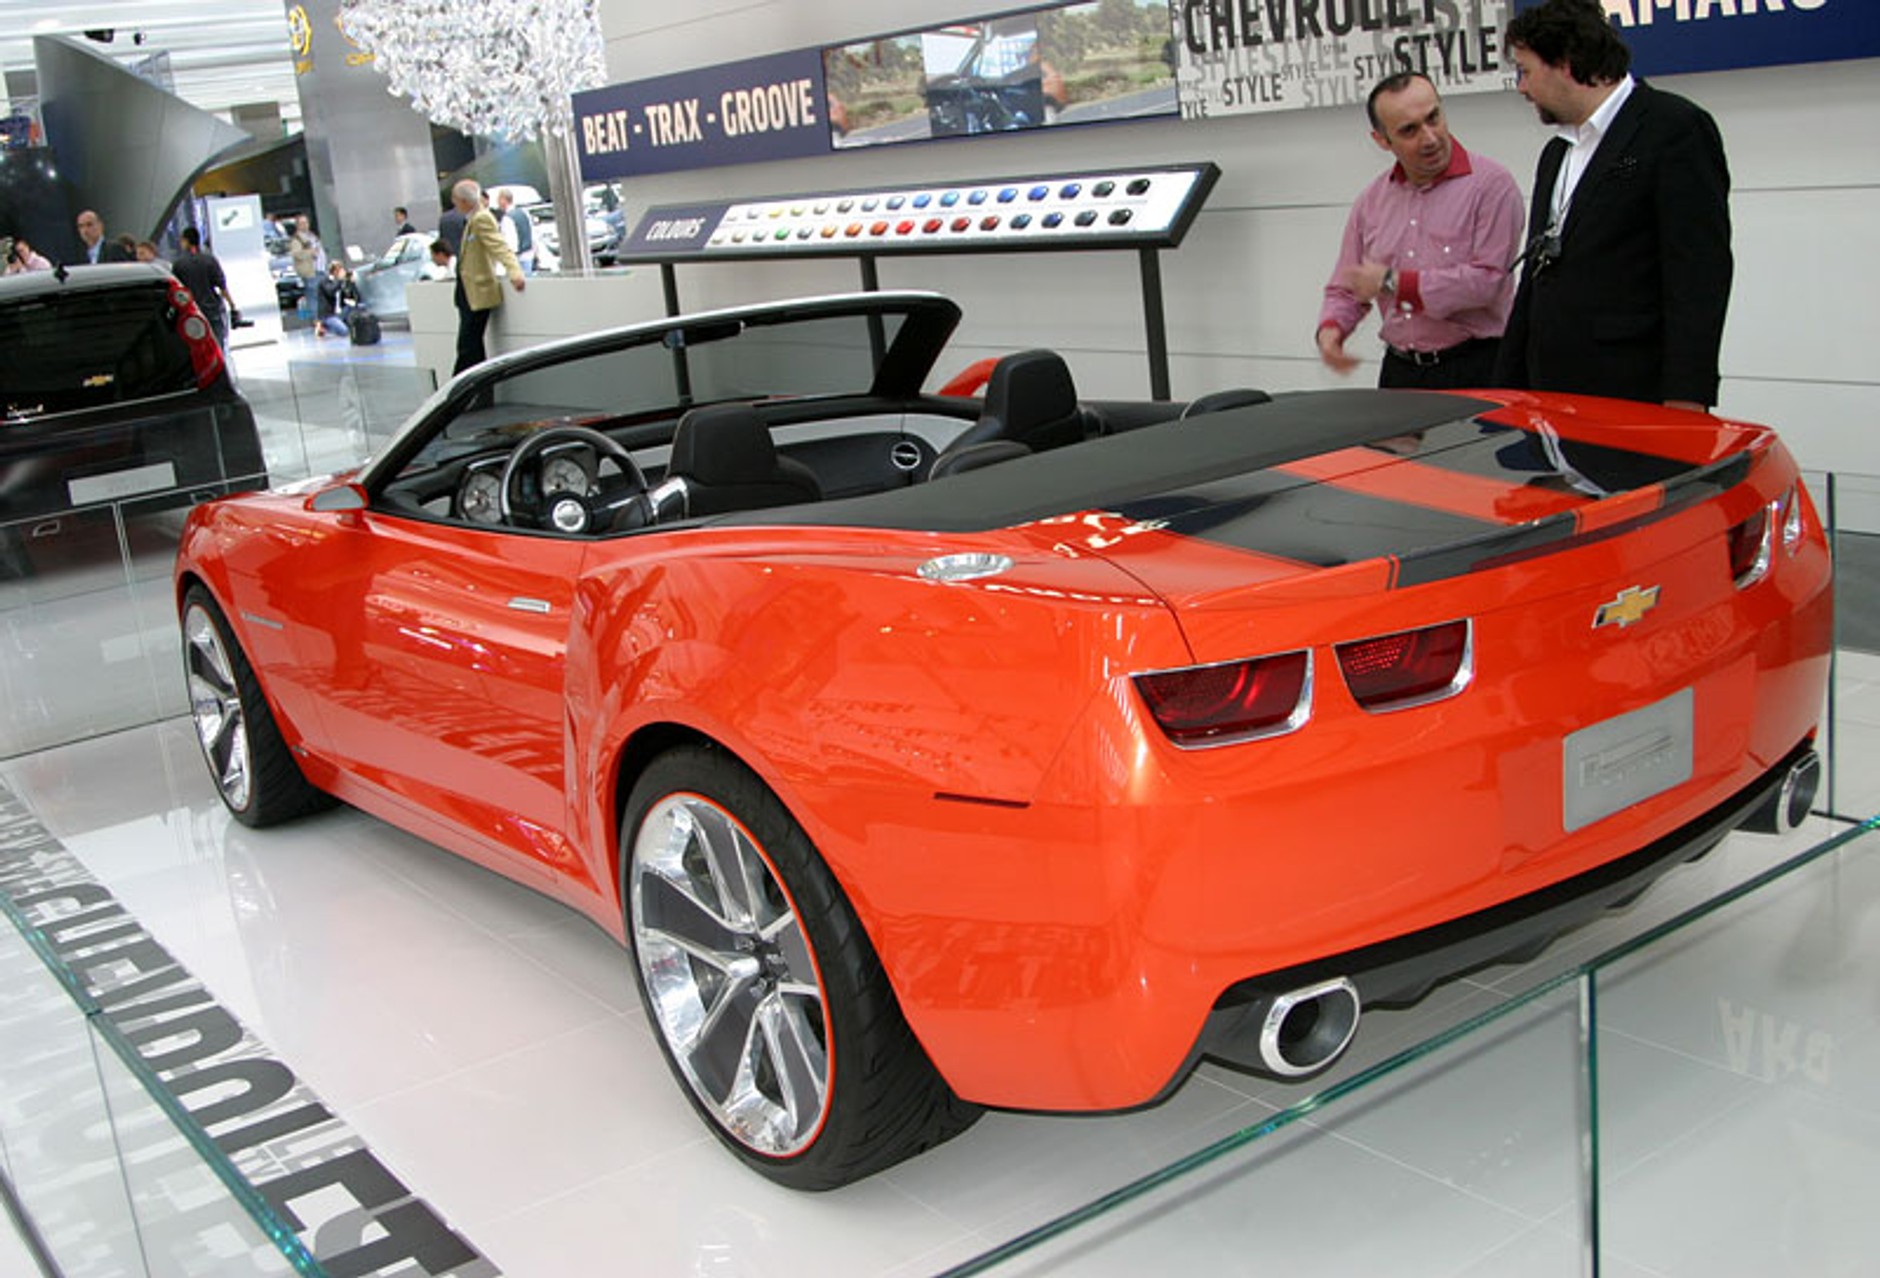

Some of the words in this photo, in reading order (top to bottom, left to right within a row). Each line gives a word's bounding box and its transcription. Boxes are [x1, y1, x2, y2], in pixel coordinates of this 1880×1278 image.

[1354, 52, 1401, 80] STYL
[1394, 26, 1499, 76] STYLE
[1222, 73, 1283, 107] STYLE
[582, 110, 628, 155] BEAT
[644, 98, 703, 147] TRAX
[721, 78, 816, 138] GROOVE
